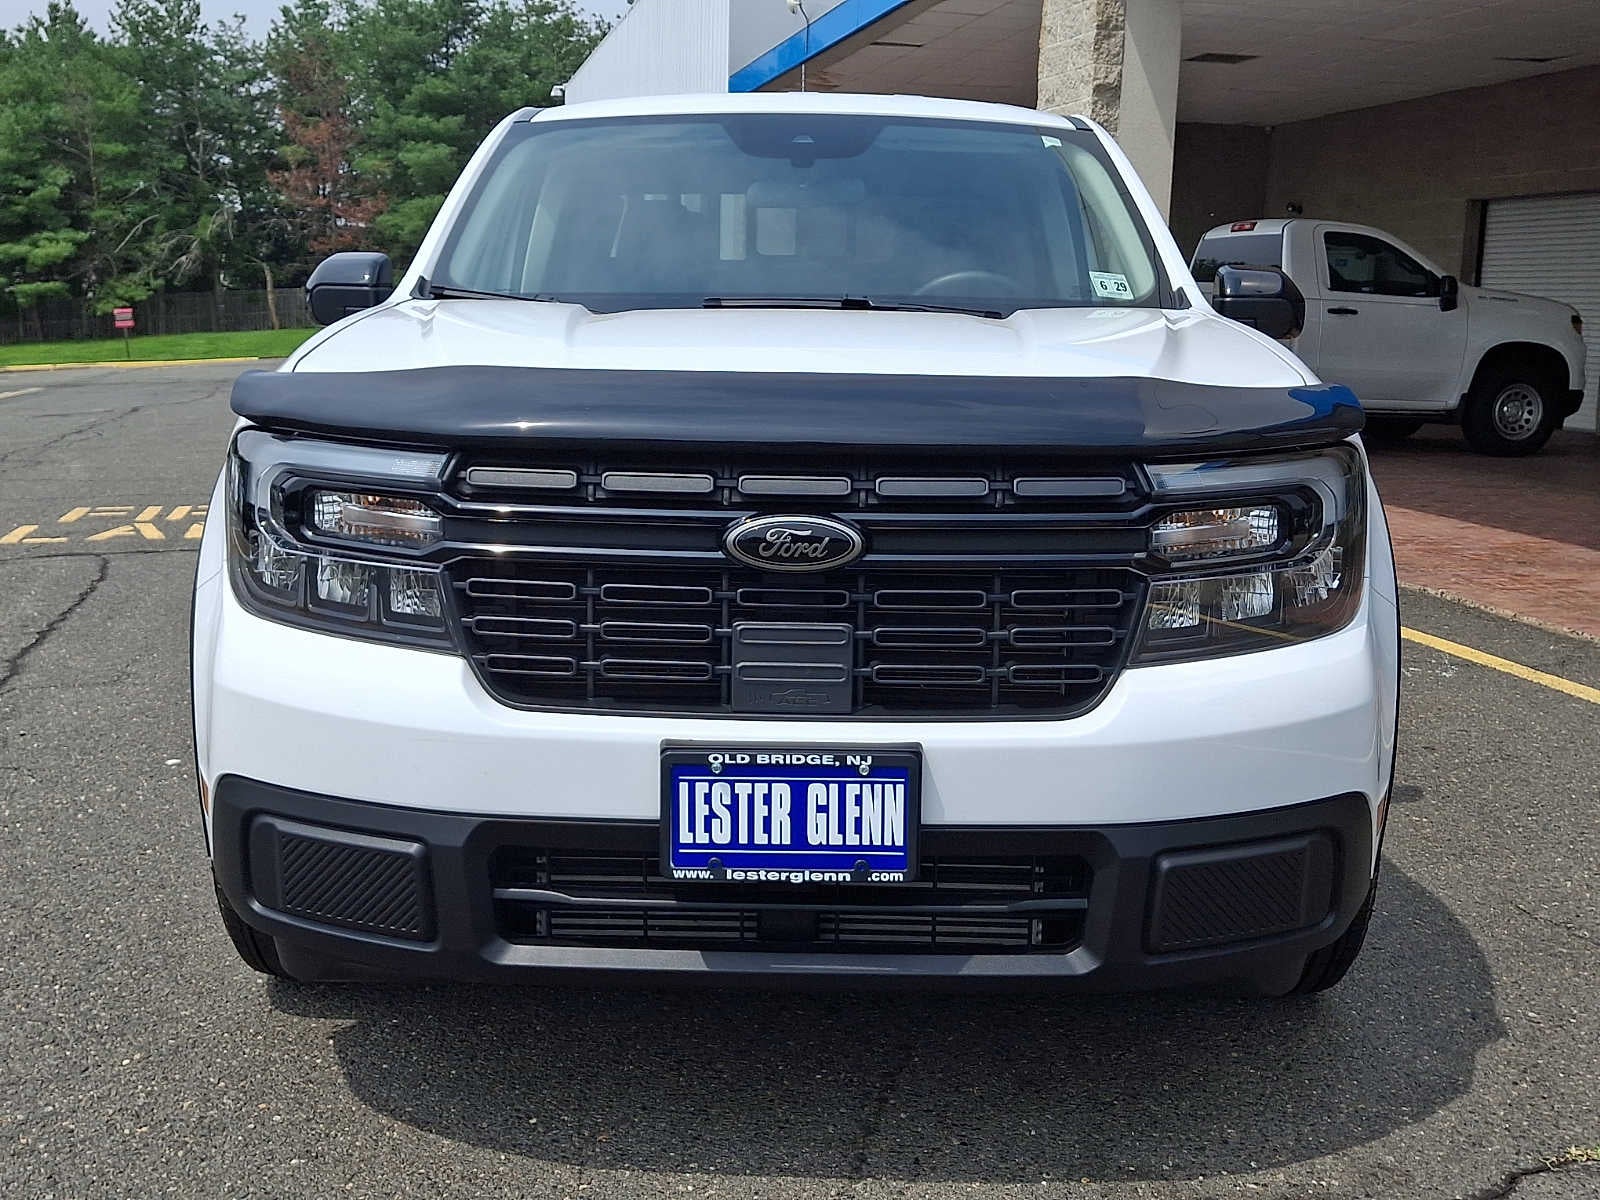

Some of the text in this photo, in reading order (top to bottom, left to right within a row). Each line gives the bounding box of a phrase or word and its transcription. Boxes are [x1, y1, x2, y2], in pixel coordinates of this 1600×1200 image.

[1099, 280, 1128, 292] 6 29
[758, 528, 829, 558] Ford
[707, 754, 872, 767] OLD BRIDGE, NJ
[678, 781, 904, 846] LESTER GLENN
[672, 869, 904, 883] www. lesterglenn .com
